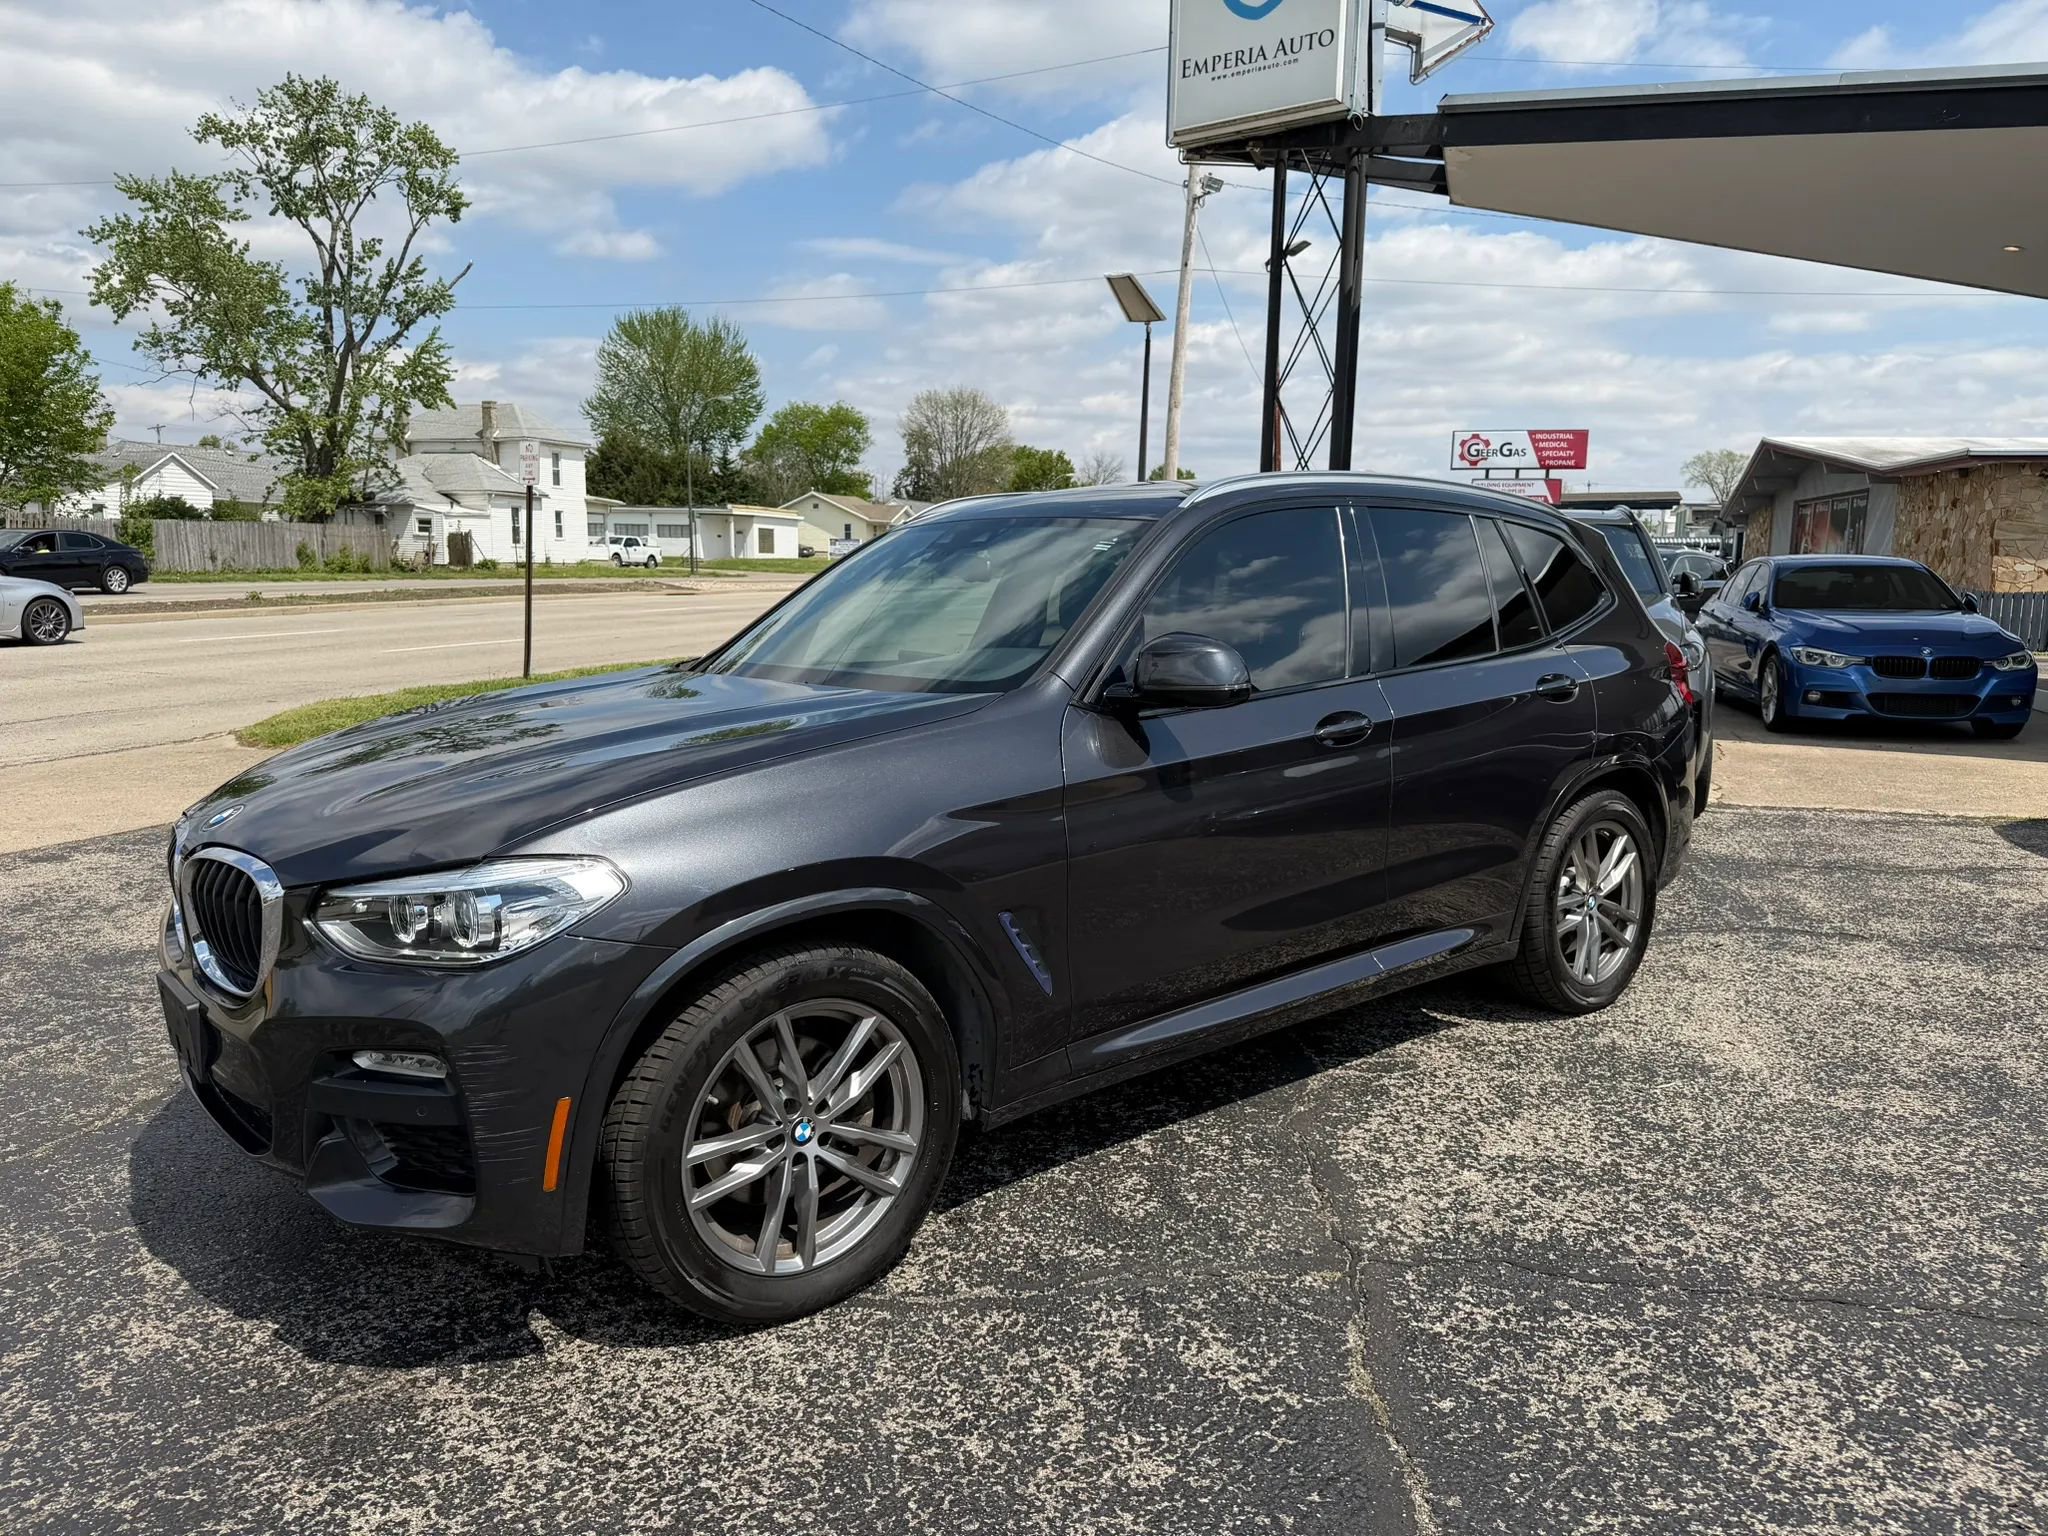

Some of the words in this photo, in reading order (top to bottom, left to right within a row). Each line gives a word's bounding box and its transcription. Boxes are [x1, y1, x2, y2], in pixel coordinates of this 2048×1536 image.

[1181, 45, 1267, 79] EMPERIA
[1272, 28, 1335, 59] AUTO
[1211, 57, 1299, 81] www.emperiaauto.com
